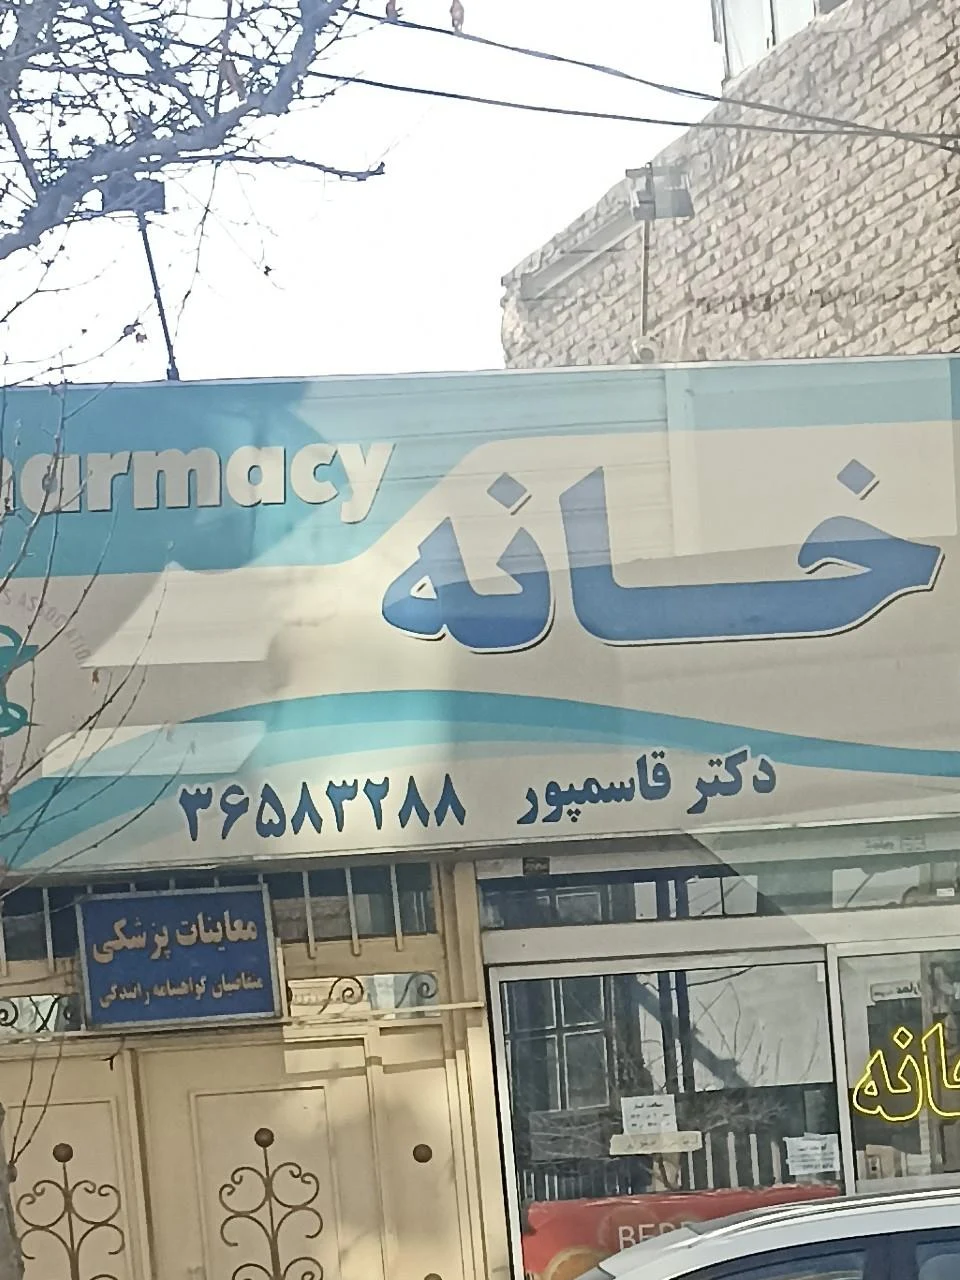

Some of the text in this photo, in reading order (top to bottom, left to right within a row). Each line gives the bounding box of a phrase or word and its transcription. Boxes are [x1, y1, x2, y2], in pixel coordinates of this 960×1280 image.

[0, 442, 396, 524] armacy
[178, 772, 467, 842] ۳۶۵۸۳۲۸۸
[515, 748, 777, 825] دکتر قاسمپور
[92, 909, 258, 964] معاینات پزشکی
